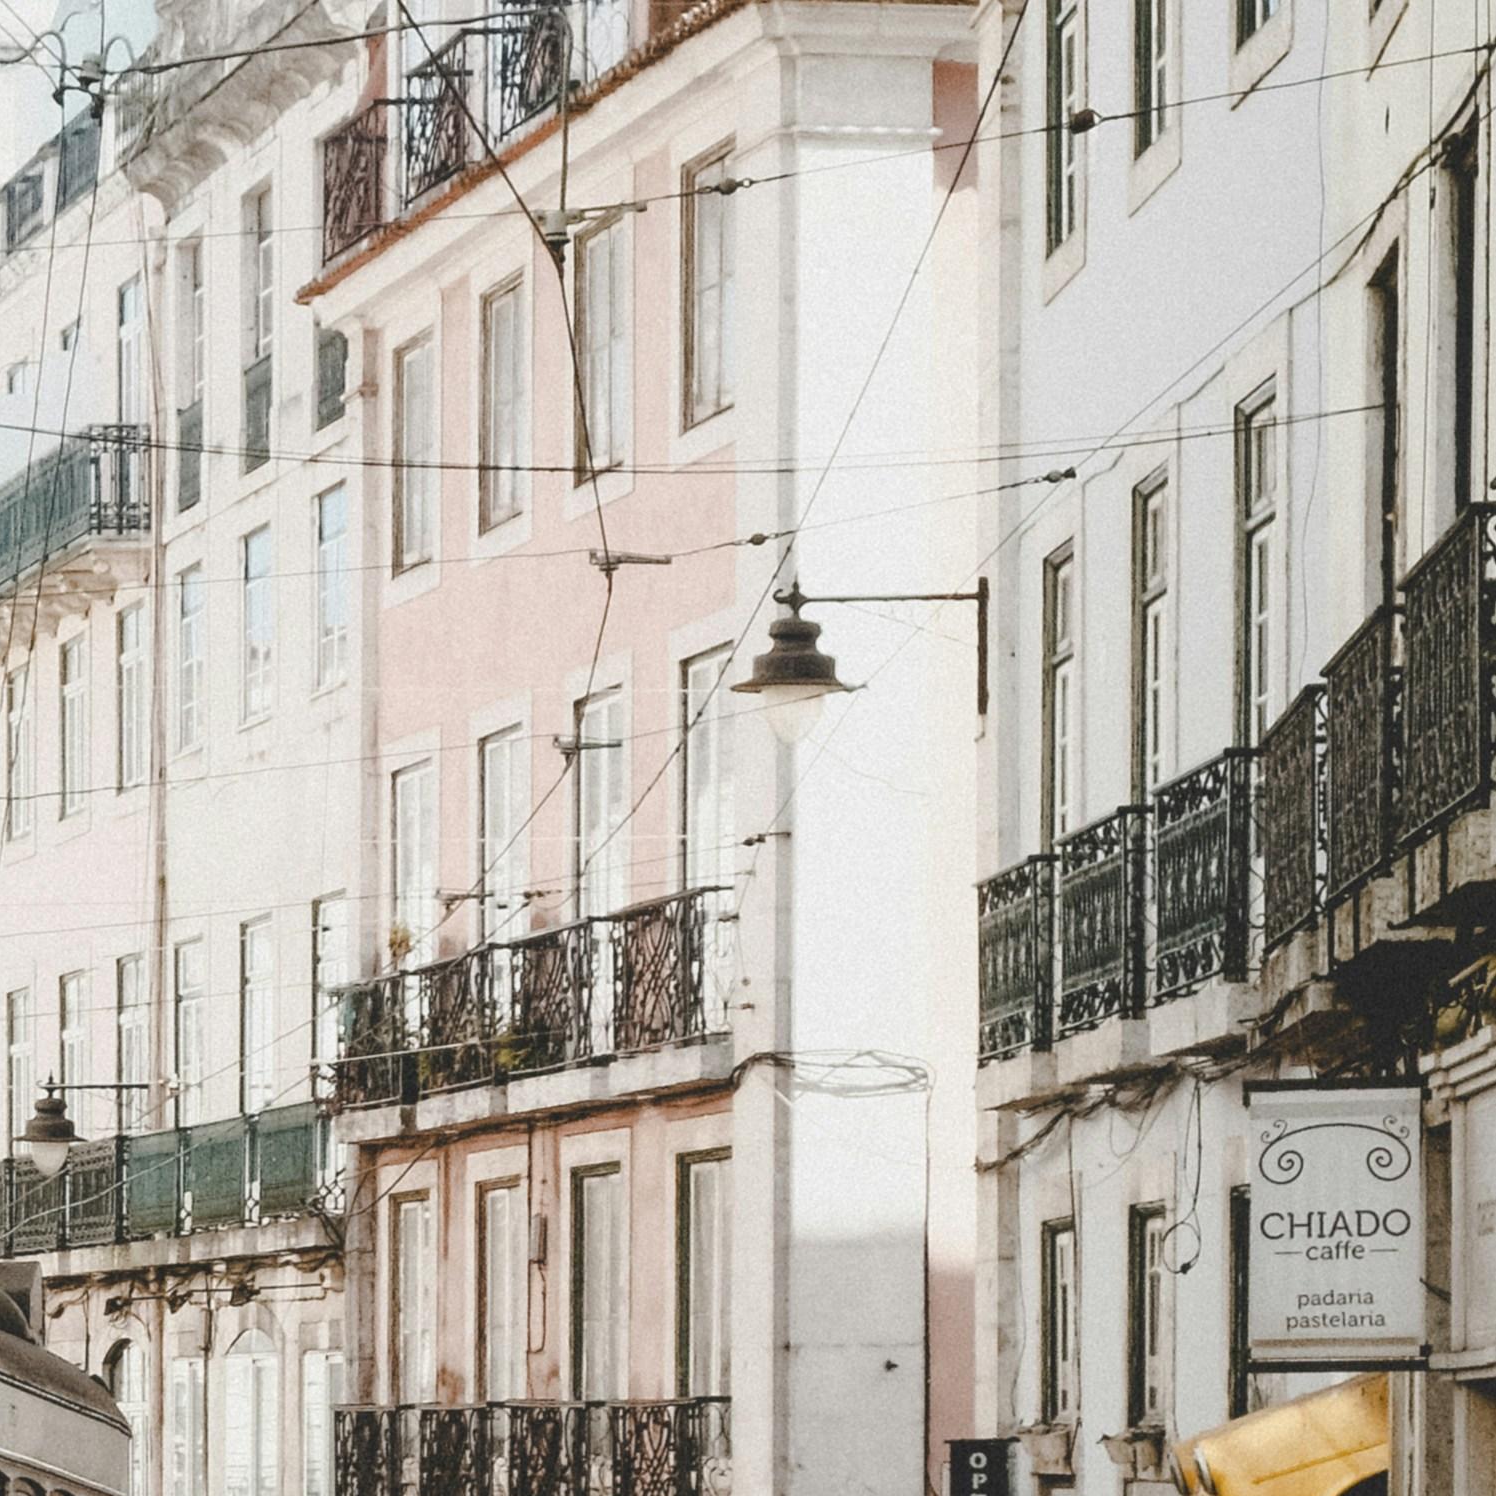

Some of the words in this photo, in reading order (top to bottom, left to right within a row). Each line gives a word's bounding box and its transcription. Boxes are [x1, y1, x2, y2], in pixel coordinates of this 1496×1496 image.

[1259, 1208, 1411, 1240] CHIADO
[1305, 1240, 1366, 1261] caffe
[1297, 1288, 1375, 1310] padaria
[1286, 1310, 1386, 1333] pastelaria
